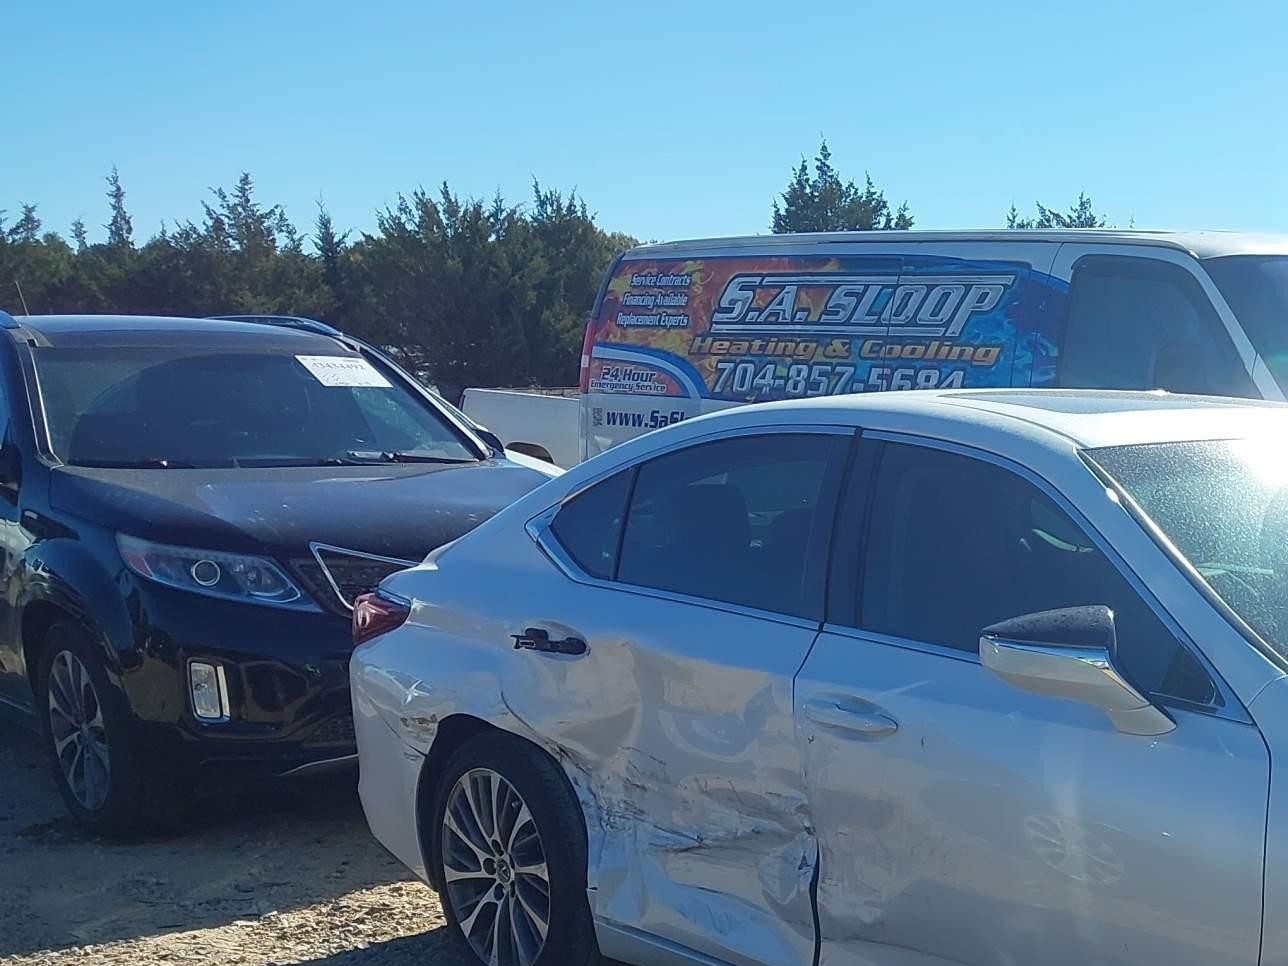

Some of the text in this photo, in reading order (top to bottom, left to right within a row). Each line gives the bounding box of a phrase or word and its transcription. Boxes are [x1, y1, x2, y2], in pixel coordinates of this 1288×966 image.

[631, 273, 690, 286] Service Contracts
[623, 292, 688, 308] Financing Available
[712, 275, 1008, 336] S.A. SLOOP
[616, 312, 689, 328] Replacement Experts
[687, 336, 1001, 366] Heating & Cooling
[601, 367, 656, 382] 24 Hour
[591, 380, 666, 393] Emergency Service
[606, 410, 691, 429] www.SaSl
